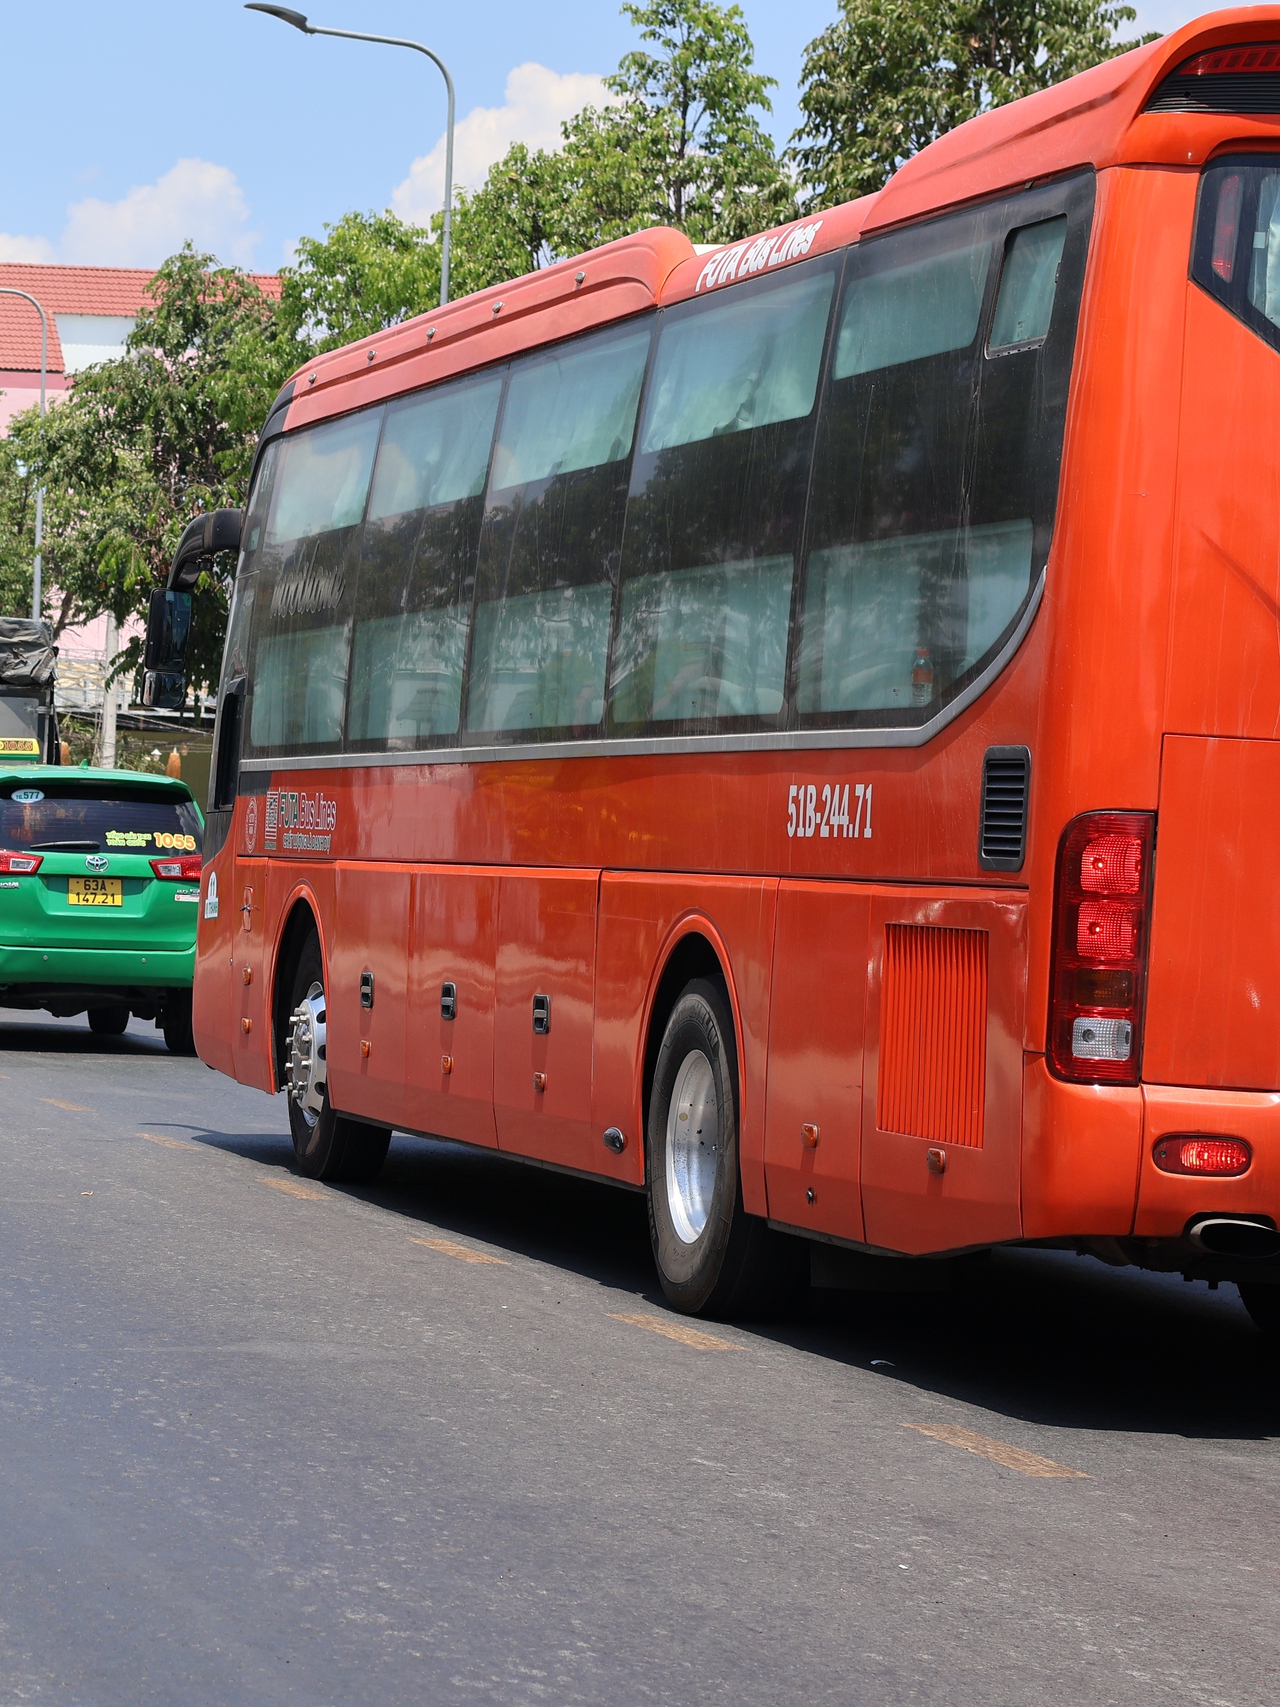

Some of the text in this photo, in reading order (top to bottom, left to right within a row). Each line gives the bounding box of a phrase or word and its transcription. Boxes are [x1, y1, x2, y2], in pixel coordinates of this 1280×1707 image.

[695, 220, 824, 292] FUTA Bus Lines
[4, 740, 33, 751] 1055
[786, 783, 873, 838] 51B-244.71
[153, 832, 196, 851] 1055
[83, 879, 107, 891] 63A
[76, 892, 115, 904] 147.21
